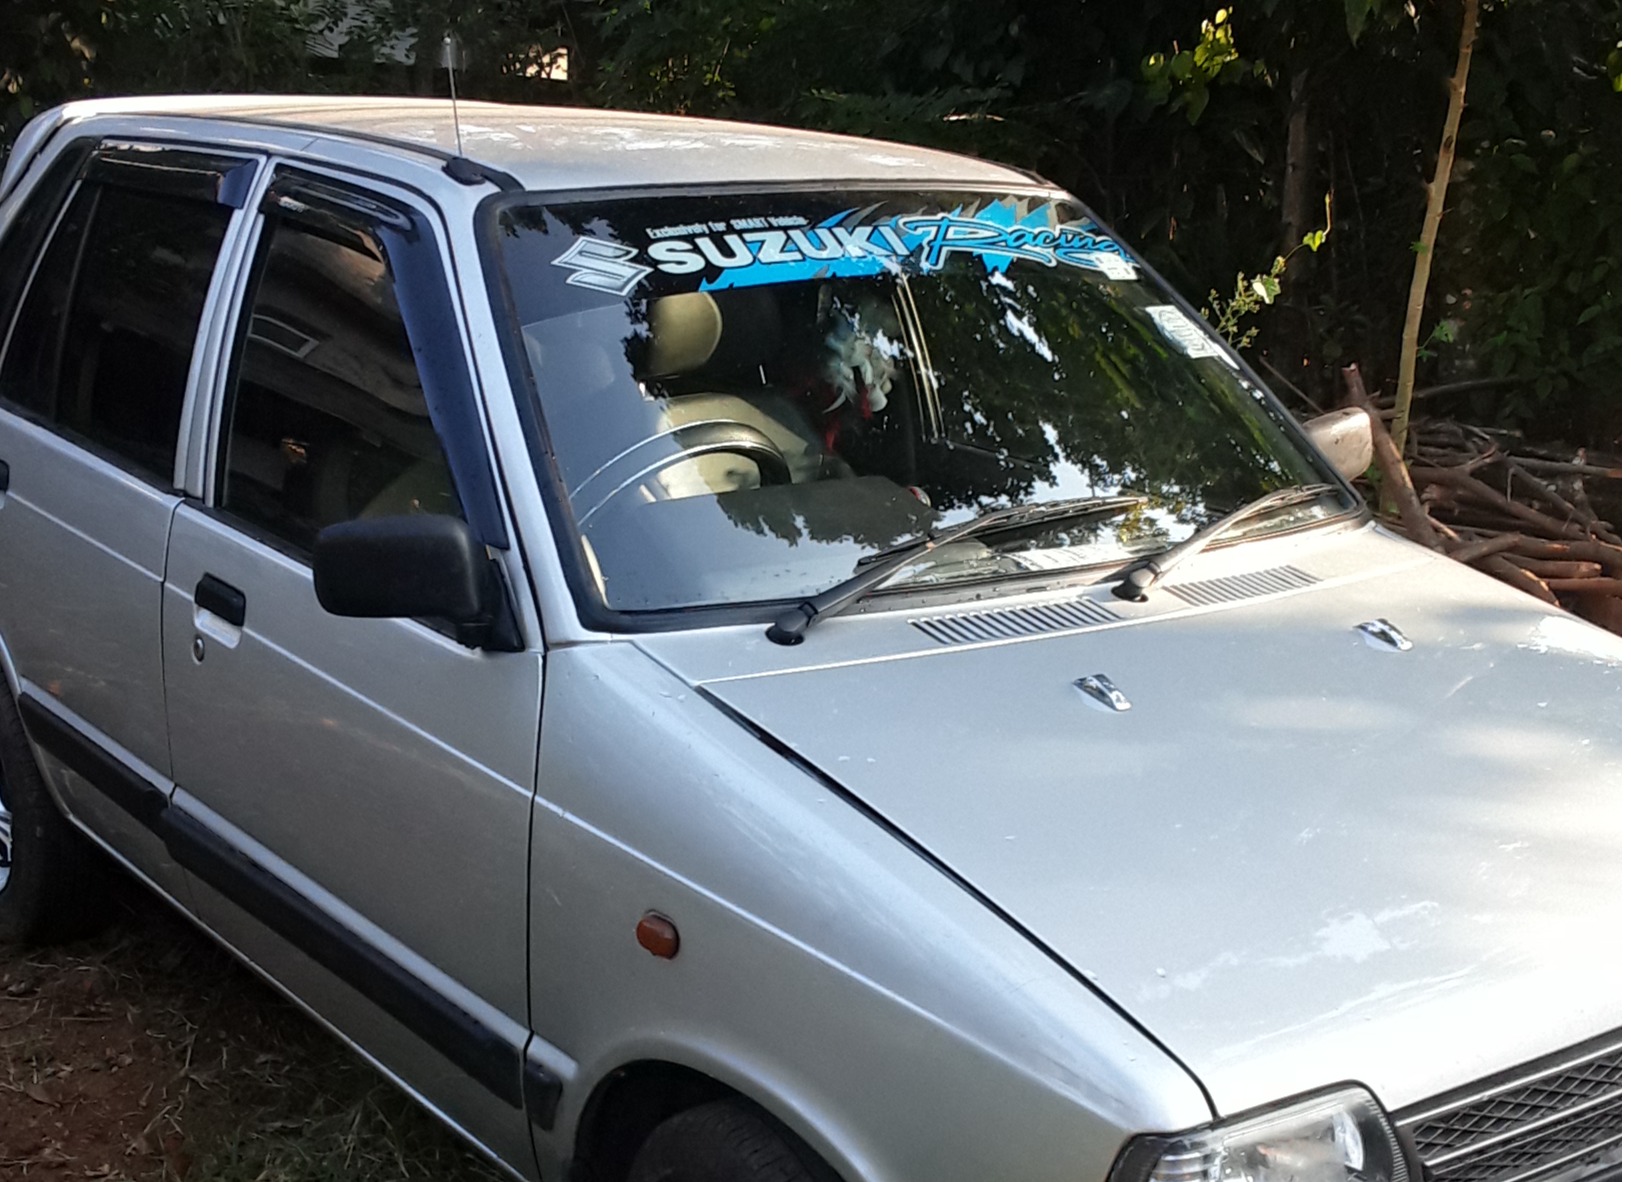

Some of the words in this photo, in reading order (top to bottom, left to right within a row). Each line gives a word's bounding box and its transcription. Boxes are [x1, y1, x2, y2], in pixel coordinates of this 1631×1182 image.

[708, 220, 727, 232] for
[730, 216, 769, 230] SMART
[647, 225, 912, 275] SUZUKI
[900, 214, 1138, 270] Racing
